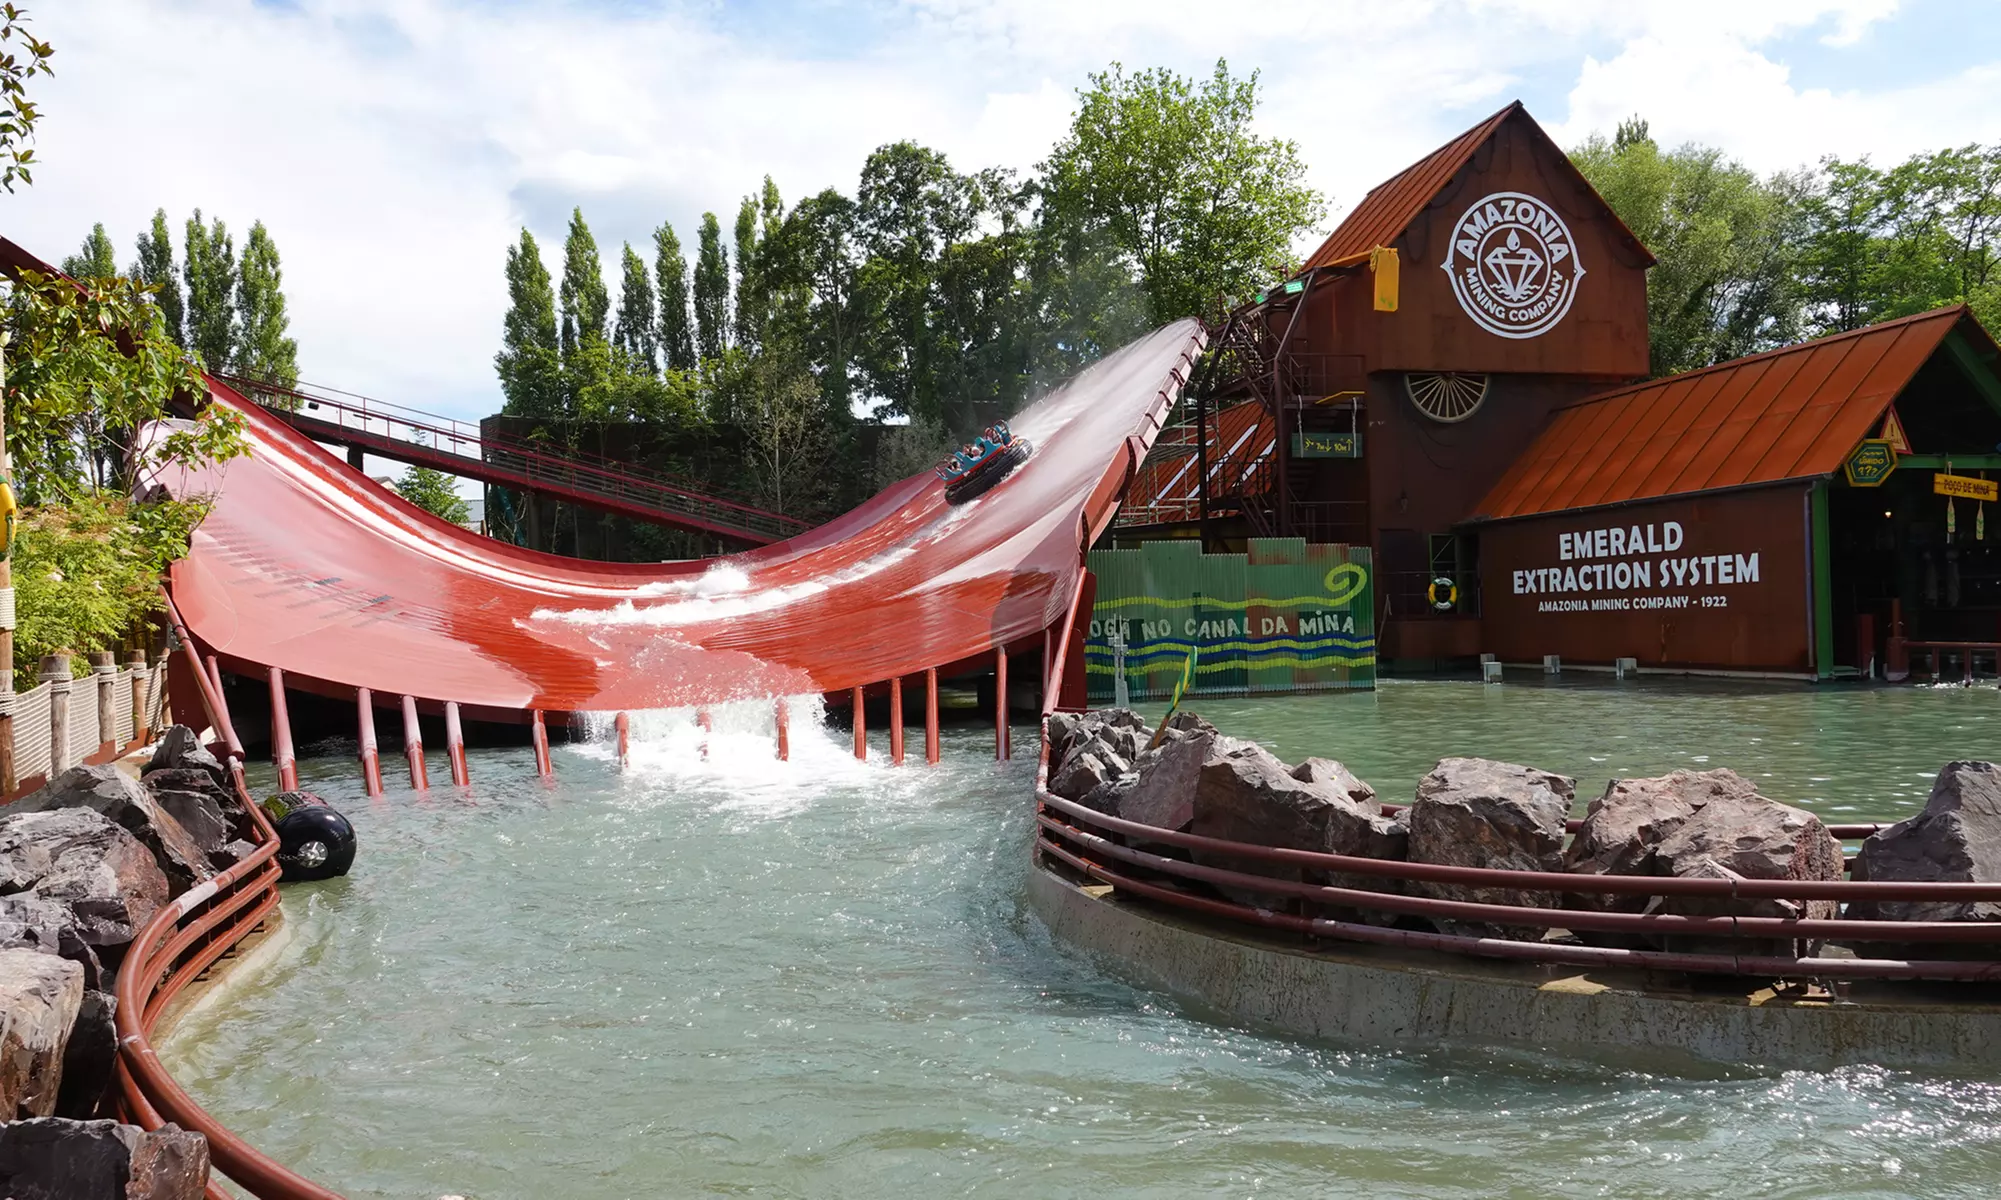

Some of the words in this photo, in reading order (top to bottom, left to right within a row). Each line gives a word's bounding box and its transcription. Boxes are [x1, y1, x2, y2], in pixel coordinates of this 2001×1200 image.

[1456, 200, 1569, 264] AMAZONIA
[1466, 267, 1506, 319] MINING
[1508, 270, 1563, 322] COMPANY
[1559, 521, 1684, 560] EMERALD
[1513, 561, 1651, 594] EXTRACTION
[1659, 553, 1760, 587] SYSTEM
[1538, 599, 1589, 612] AMAZONIA
[1591, 597, 1630, 611] MINING
[1632, 595, 1689, 609] COMPANY
[1700, 596, 1728, 608] 1922
[1141, 619, 1172, 641] NO
[1184, 616, 1252, 640] CANAL
[1261, 616, 1289, 636] DA
